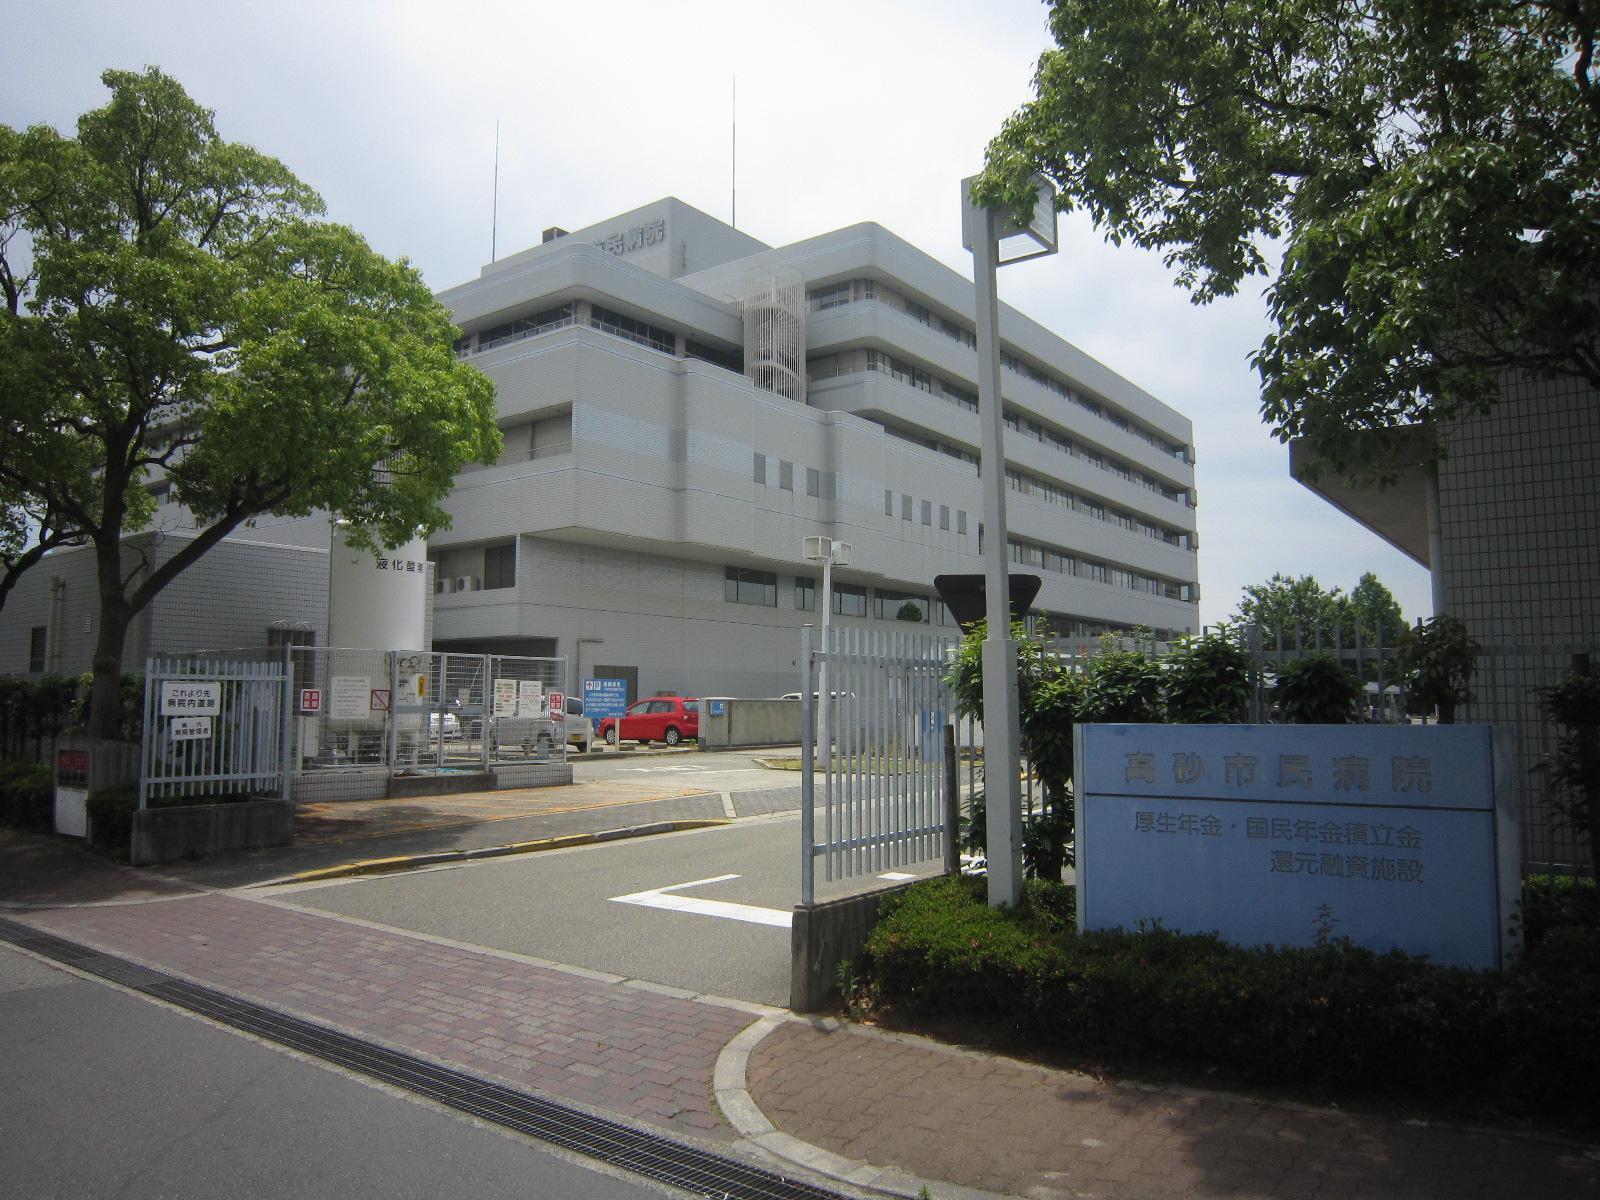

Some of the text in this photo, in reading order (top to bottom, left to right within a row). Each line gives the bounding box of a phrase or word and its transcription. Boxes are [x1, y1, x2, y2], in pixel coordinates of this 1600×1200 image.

[167, 699, 215, 708] 病院内道路
[172, 689, 210, 698] これより先
[1125, 751, 1432, 793] 高砂市民病院
[1270, 849, 1424, 884] 還元融資施設
